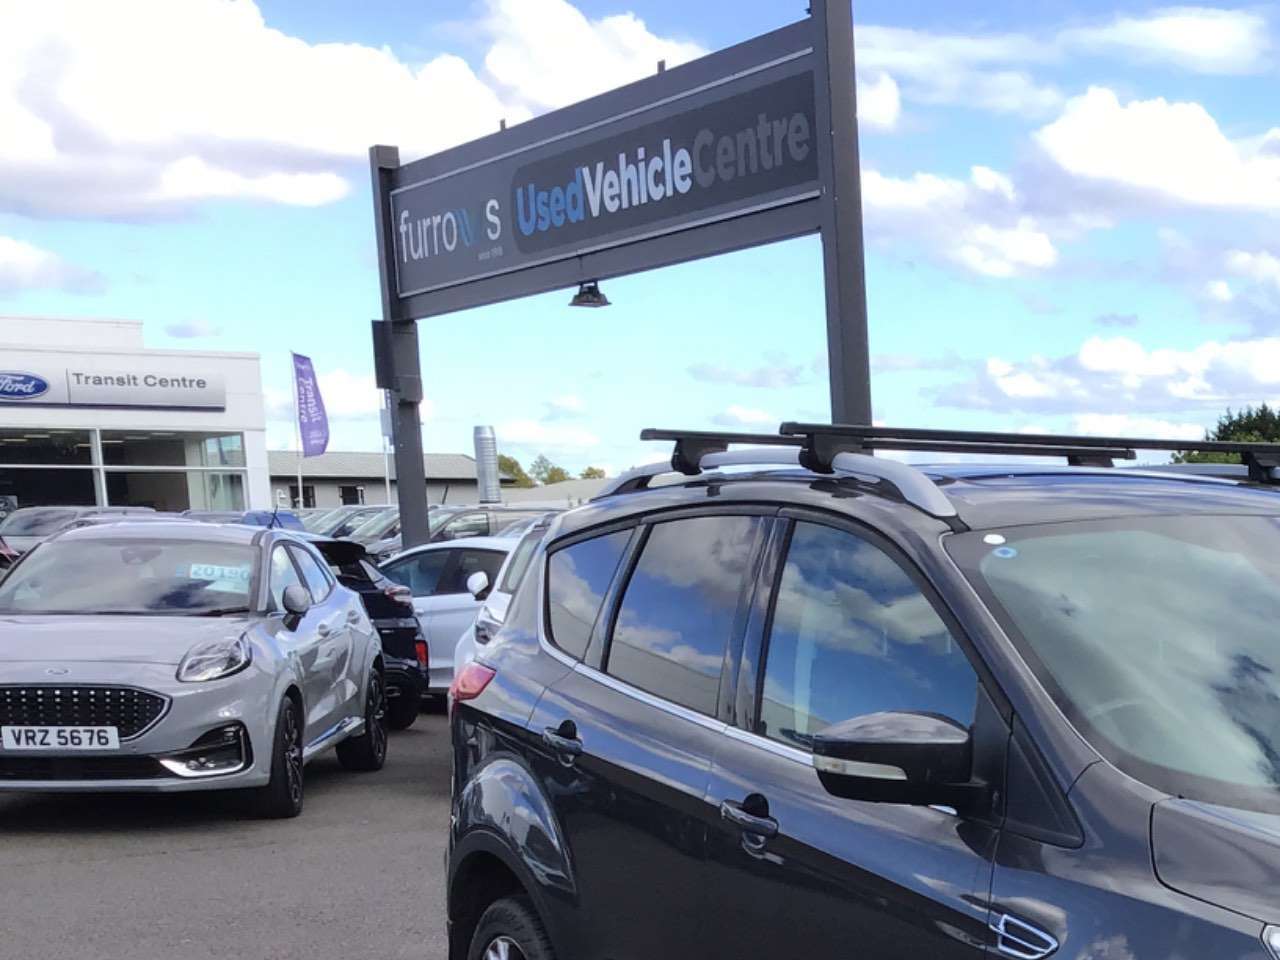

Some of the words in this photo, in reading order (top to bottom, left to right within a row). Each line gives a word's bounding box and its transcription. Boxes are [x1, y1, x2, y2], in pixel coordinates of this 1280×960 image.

[0, 375, 35, 393] Ford
[72, 372, 139, 387] Transit
[143, 374, 207, 389] Centre
[11, 729, 51, 746] VRZ
[57, 729, 109, 746] 5676
